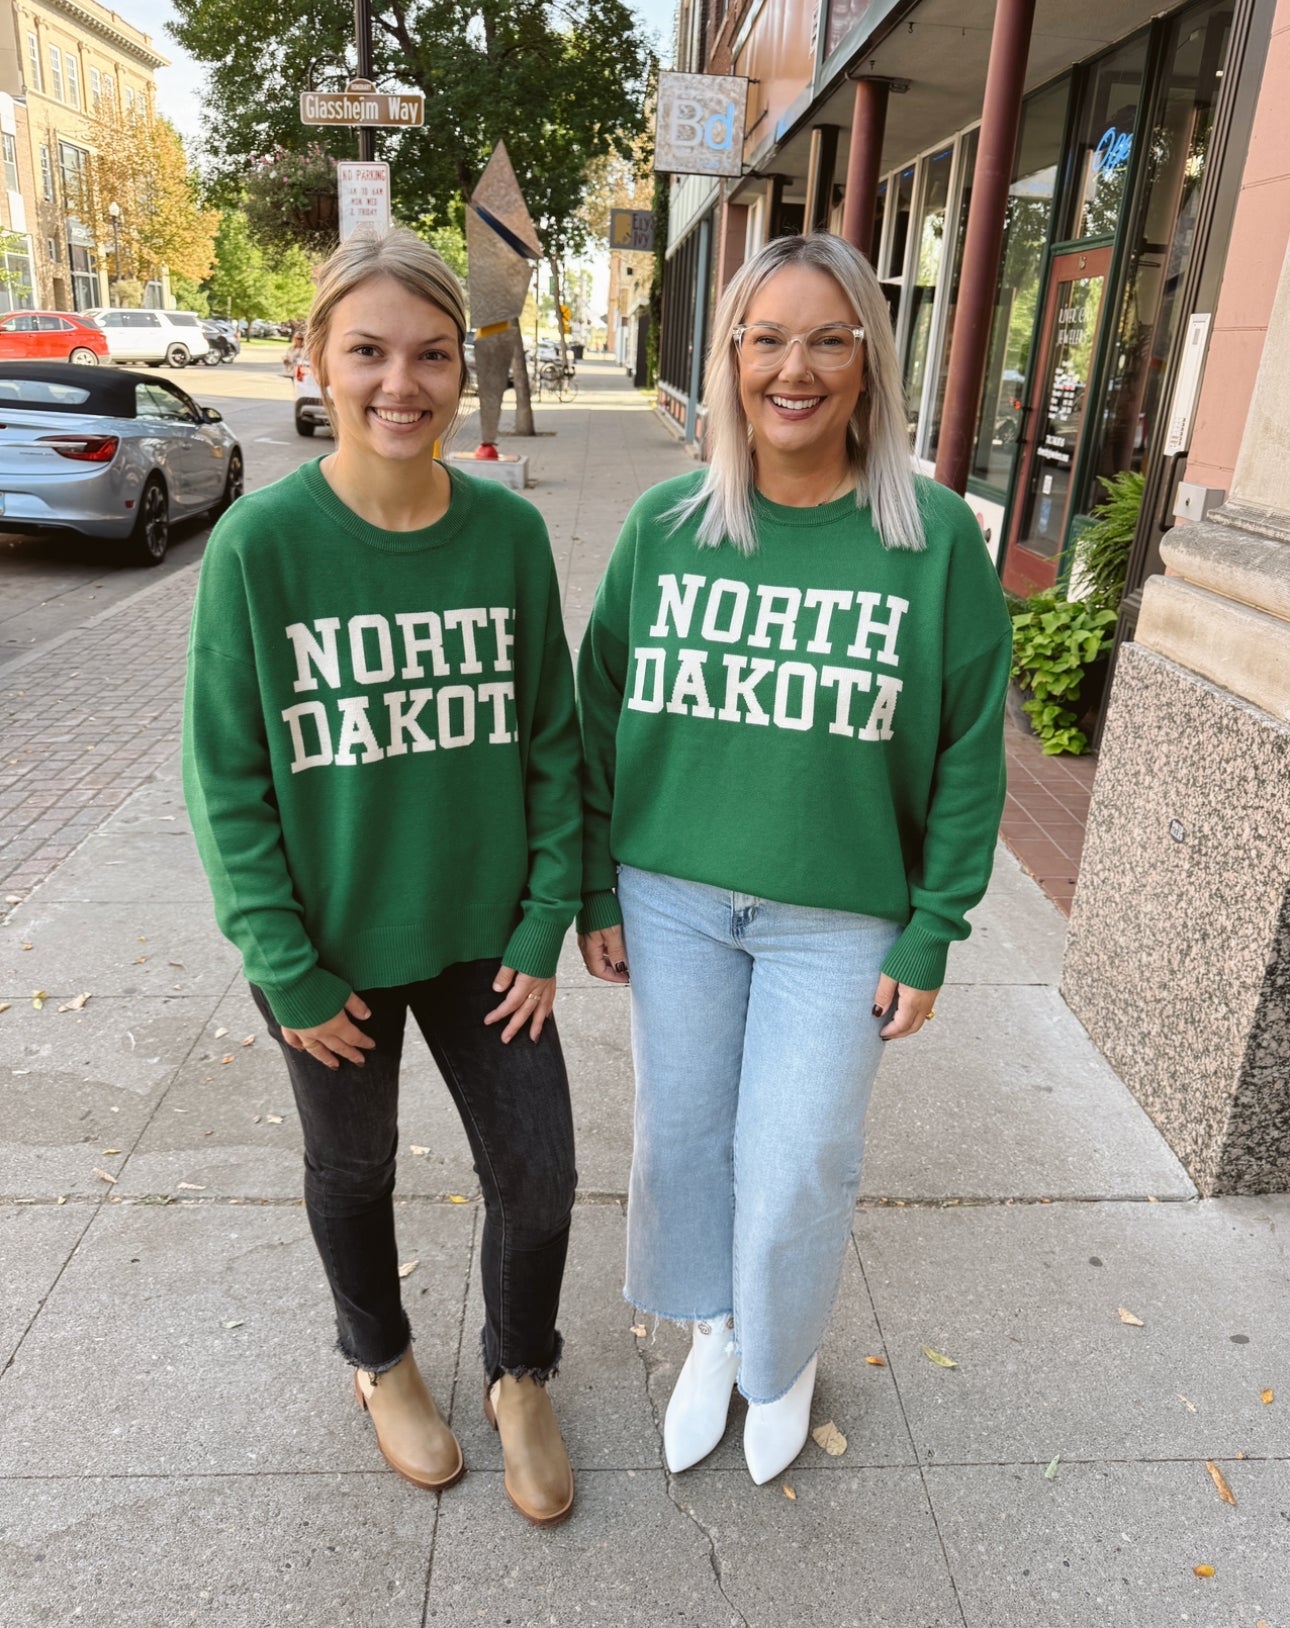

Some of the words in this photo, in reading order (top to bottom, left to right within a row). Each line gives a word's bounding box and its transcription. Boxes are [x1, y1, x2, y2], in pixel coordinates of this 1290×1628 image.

[305, 95, 379, 122] Glassheim
[388, 96, 418, 124] Way
[356, 169, 386, 181] PARKING
[649, 573, 910, 667] NORTH
[281, 681, 519, 774] DAKOT
[627, 647, 904, 741] DAKOTA
